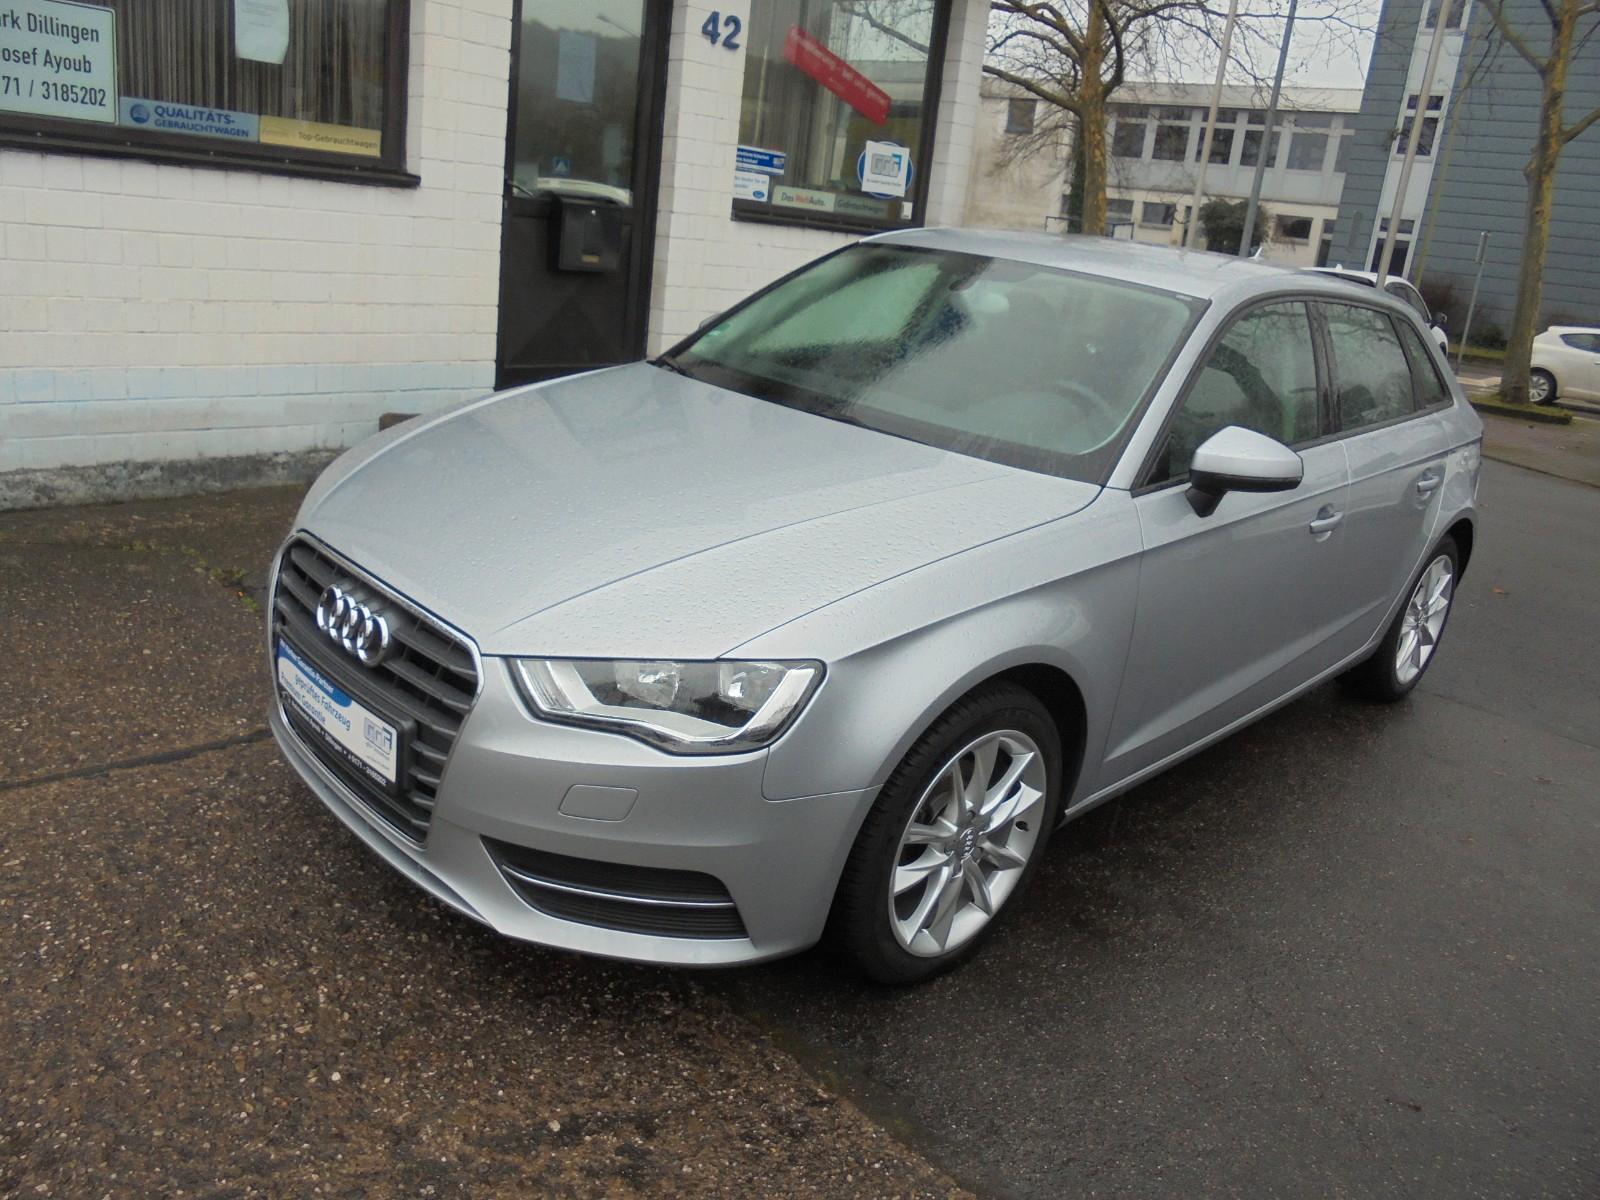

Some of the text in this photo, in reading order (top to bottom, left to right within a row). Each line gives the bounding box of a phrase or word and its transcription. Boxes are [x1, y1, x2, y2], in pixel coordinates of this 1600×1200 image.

[27, 12, 99, 44] Dillingen
[701, 11, 742, 50] 42
[2, 47, 92, 74] osef Ayoub
[2, 75, 20, 97] 71
[41, 81, 106, 107] 3185202
[154, 119, 249, 138] GEBRAUCHTWAGEN
